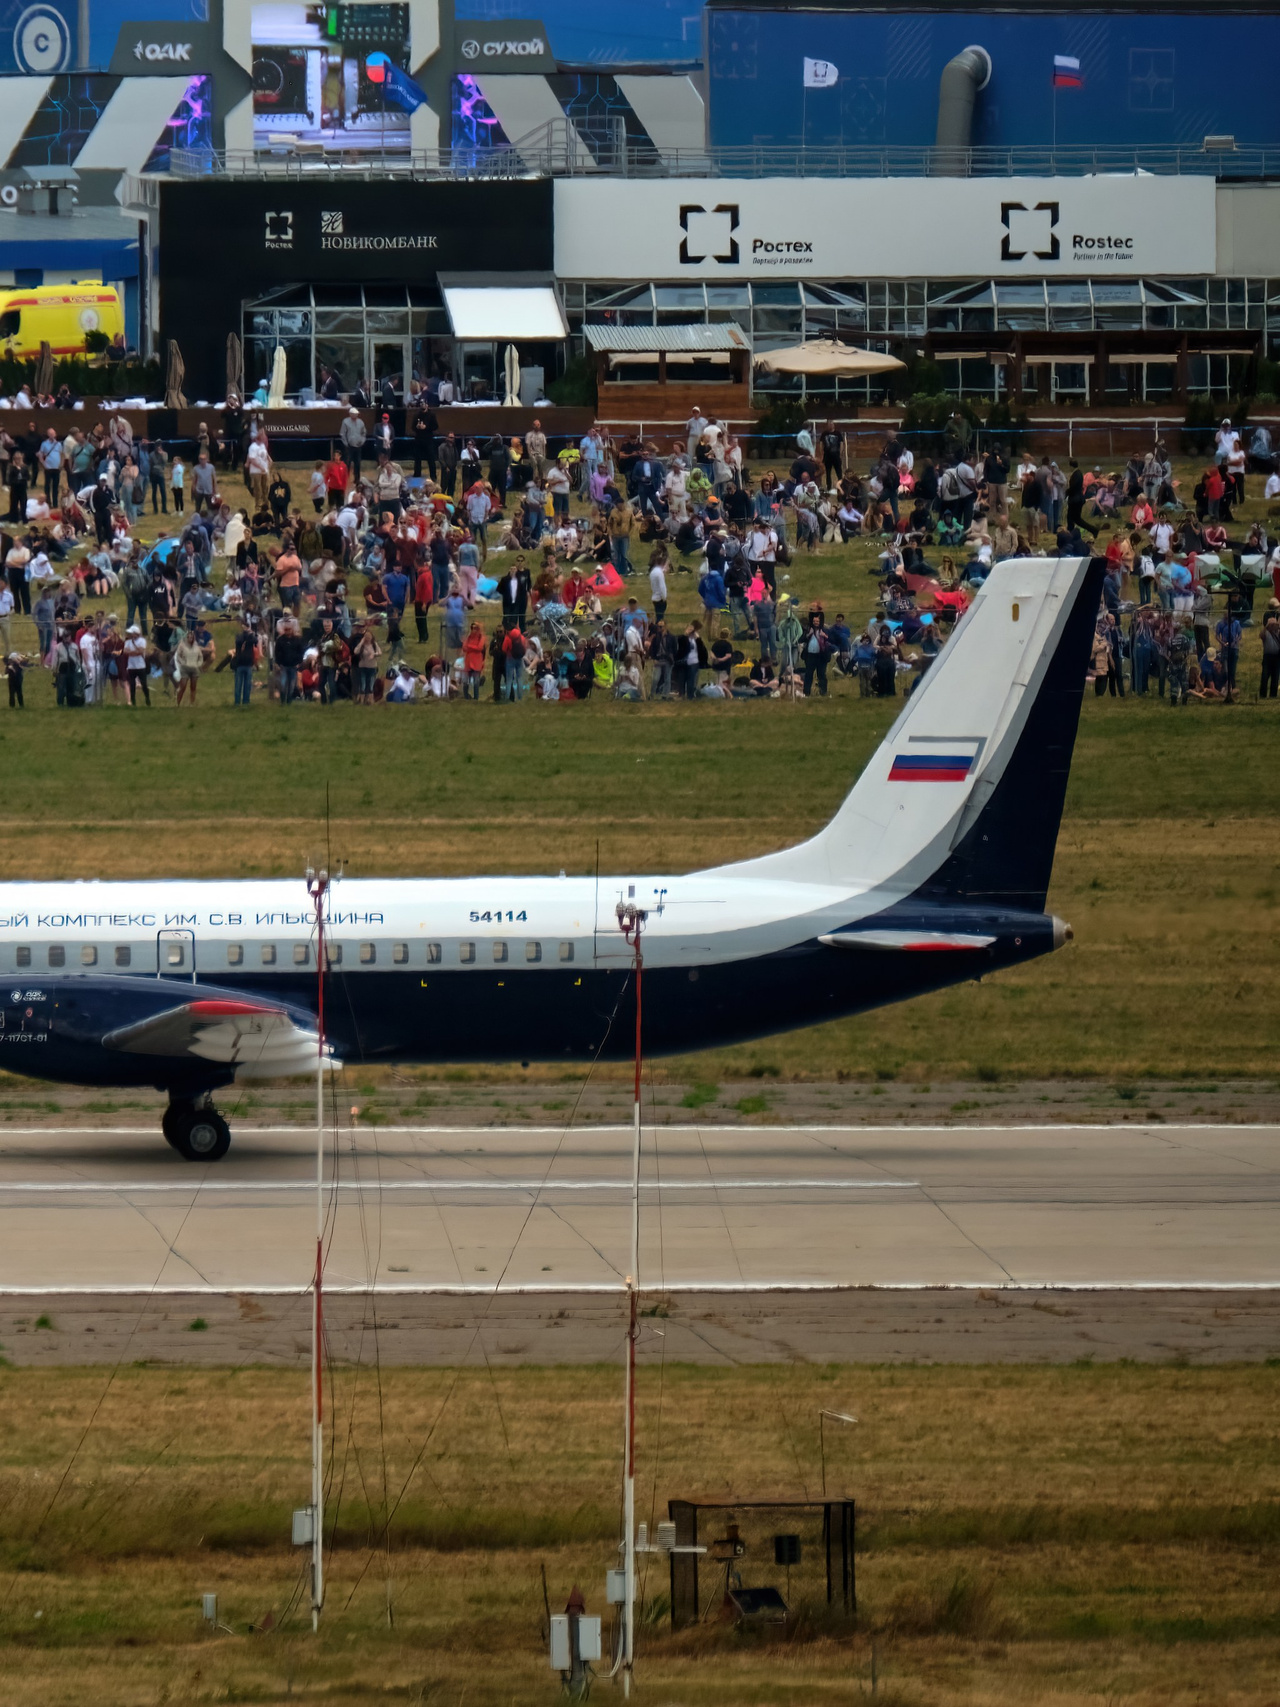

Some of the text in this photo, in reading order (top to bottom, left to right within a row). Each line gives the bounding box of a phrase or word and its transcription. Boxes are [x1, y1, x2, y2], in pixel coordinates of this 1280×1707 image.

[145, 43, 192, 61] ОАК
[483, 38, 544, 56] СУХОЙ
[321, 236, 438, 249] НОВИКОМБАНК
[752, 238, 813, 254] Ростех
[1072, 234, 1134, 249] Rostec
[164, 913, 201, 926] ИМ.
[469, 910, 528, 923] 54114
